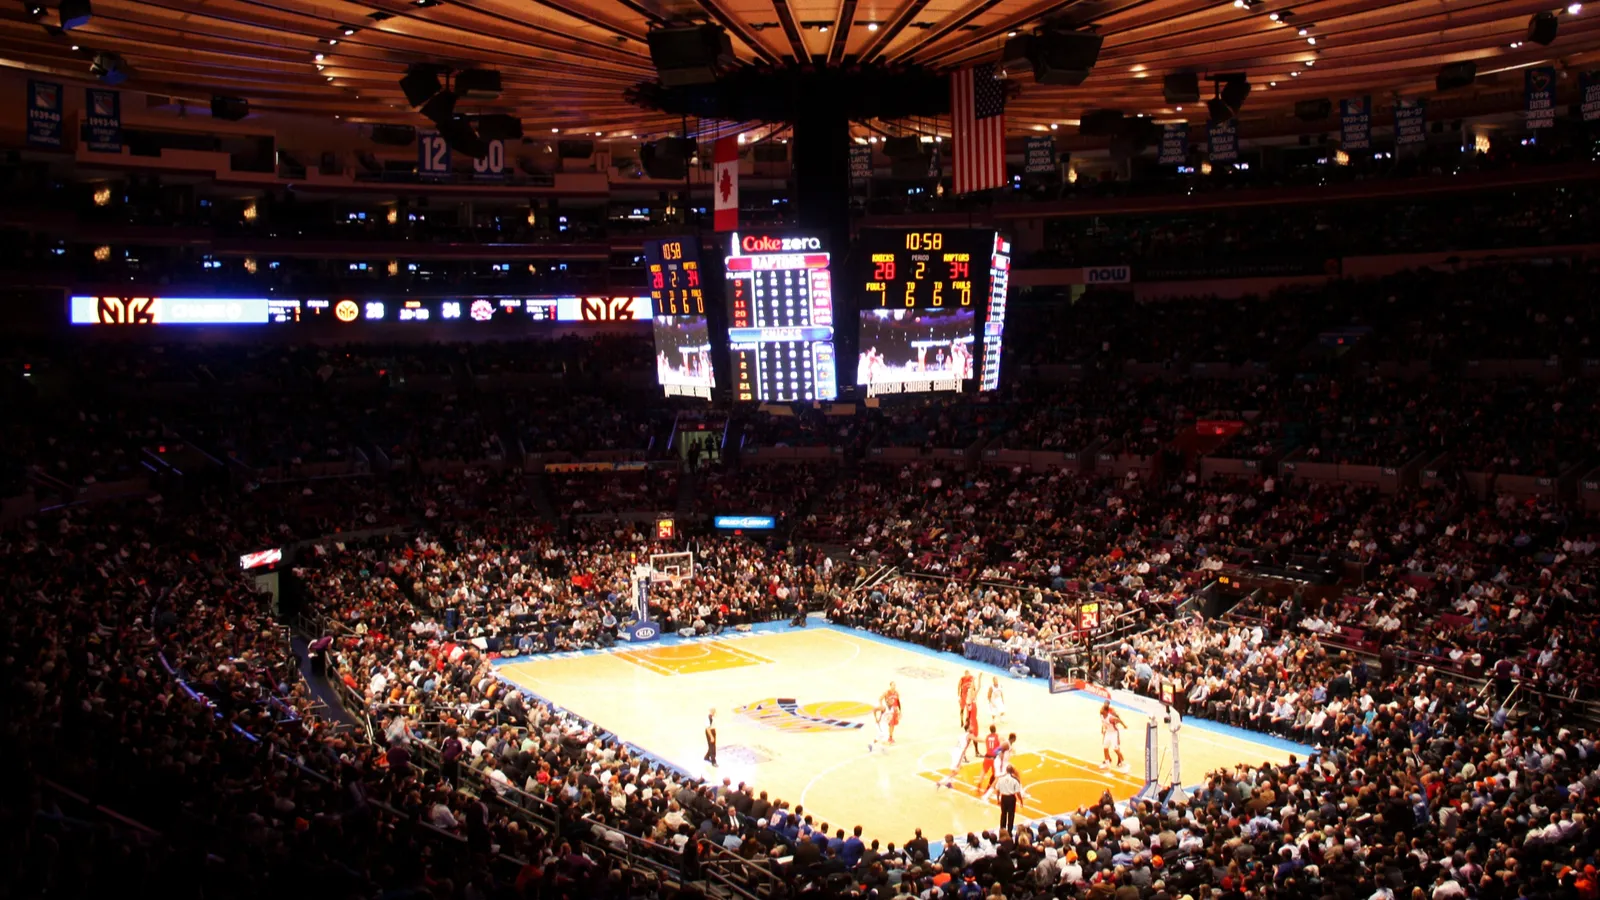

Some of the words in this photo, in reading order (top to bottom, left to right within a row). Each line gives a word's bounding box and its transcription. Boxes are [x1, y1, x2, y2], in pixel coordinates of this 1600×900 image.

[423, 137, 446, 170] 12
[743, 236, 780, 251] Coke
[782, 238, 820, 250] zero
[906, 233, 942, 250] 10:58
[872, 254, 894, 262] KNICKS
[944, 254, 969, 262] RAPTORS
[874, 262, 895, 280] 28
[915, 262, 925, 279] 2
[950, 262, 968, 279] 34
[1089, 268, 1126, 280] now
[652, 272, 664, 289] 28
[671, 271, 677, 287] 2
[866, 282, 886, 291] FOULS
[953, 281, 971, 289] FOULS
[670, 298, 677, 314] 6
[683, 297, 689, 314] 6
[882, 291, 885, 306] 1
[906, 290, 915, 307] 6
[933, 290, 942, 306] 6
[961, 289, 970, 306] 0
[867, 382, 904, 398] MADISON
[904, 381, 932, 392] SQUARE
[934, 379, 962, 393] GARDEN
[660, 527, 671, 538] 24
[1082, 613, 1097, 628] 24
[637, 629, 654, 638] KIA
